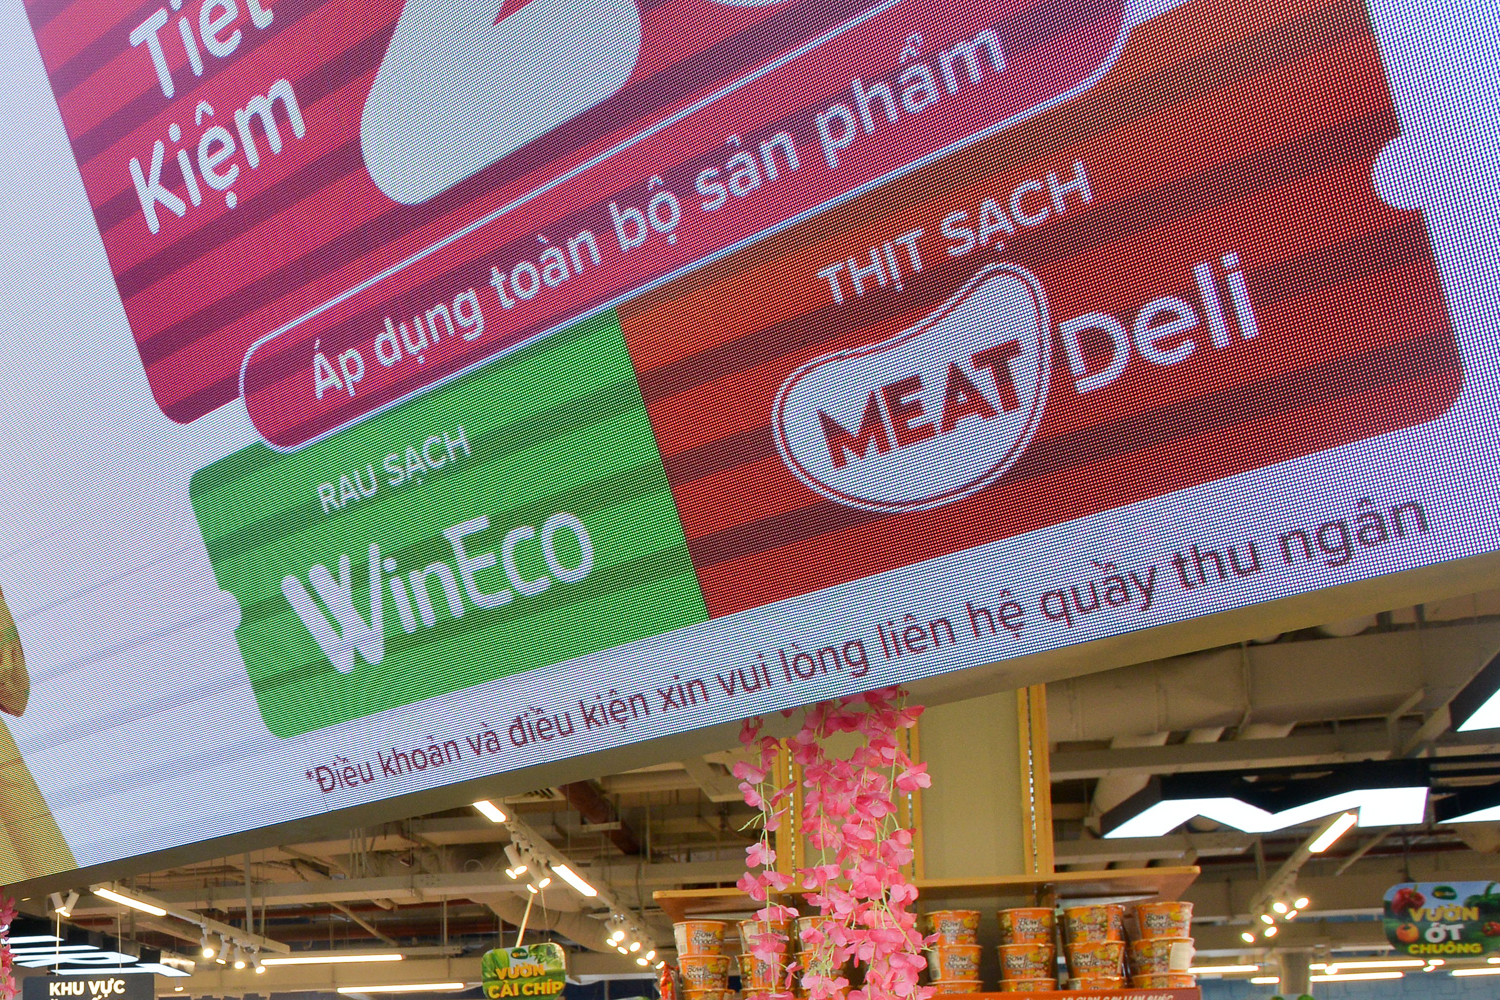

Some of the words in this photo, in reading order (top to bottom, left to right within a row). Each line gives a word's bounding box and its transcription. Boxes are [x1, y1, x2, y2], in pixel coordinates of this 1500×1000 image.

[128, 77, 307, 235] Kiệm
[311, 337, 366, 400] Áp
[374, 287, 486, 365] dụng
[489, 228, 602, 310] toàn
[607, 175, 682, 245] bộ
[695, 131, 801, 213] sản
[814, 27, 1007, 169] phẩm
[816, 229, 926, 305] THỊT
[938, 159, 1095, 258] SẠCH
[817, 338, 1027, 471] MEAT
[1057, 250, 1263, 396] Deli
[316, 469, 378, 515] RAU
[384, 425, 472, 490] SẠCH
[281, 511, 595, 676] WinEco
[382, 733, 463, 780] khoản
[467, 720, 502, 759] và
[508, 704, 576, 750] điều
[581, 684, 651, 731] kiện
[658, 673, 710, 713] xin
[715, 652, 773, 699] vui
[776, 637, 871, 684] lòng
[878, 610, 956, 661] liên
[964, 587, 1025, 642] hệ
[1038, 556, 1158, 629] quầy
[1171, 538, 1262, 591] thu
[1276, 496, 1431, 569] ngân
[1407, 941, 1483, 955] CHUÔNG
[1409, 903, 1480, 922] VƯỜN
[1424, 922, 1465, 943] ỚT
[49, 980, 85, 997] KHU
[88, 977, 126, 997] VỰC
[487, 980, 519, 999] CẢI
[521, 979, 565, 996] CHÍP
[495, 961, 546, 980] VƯỜN
